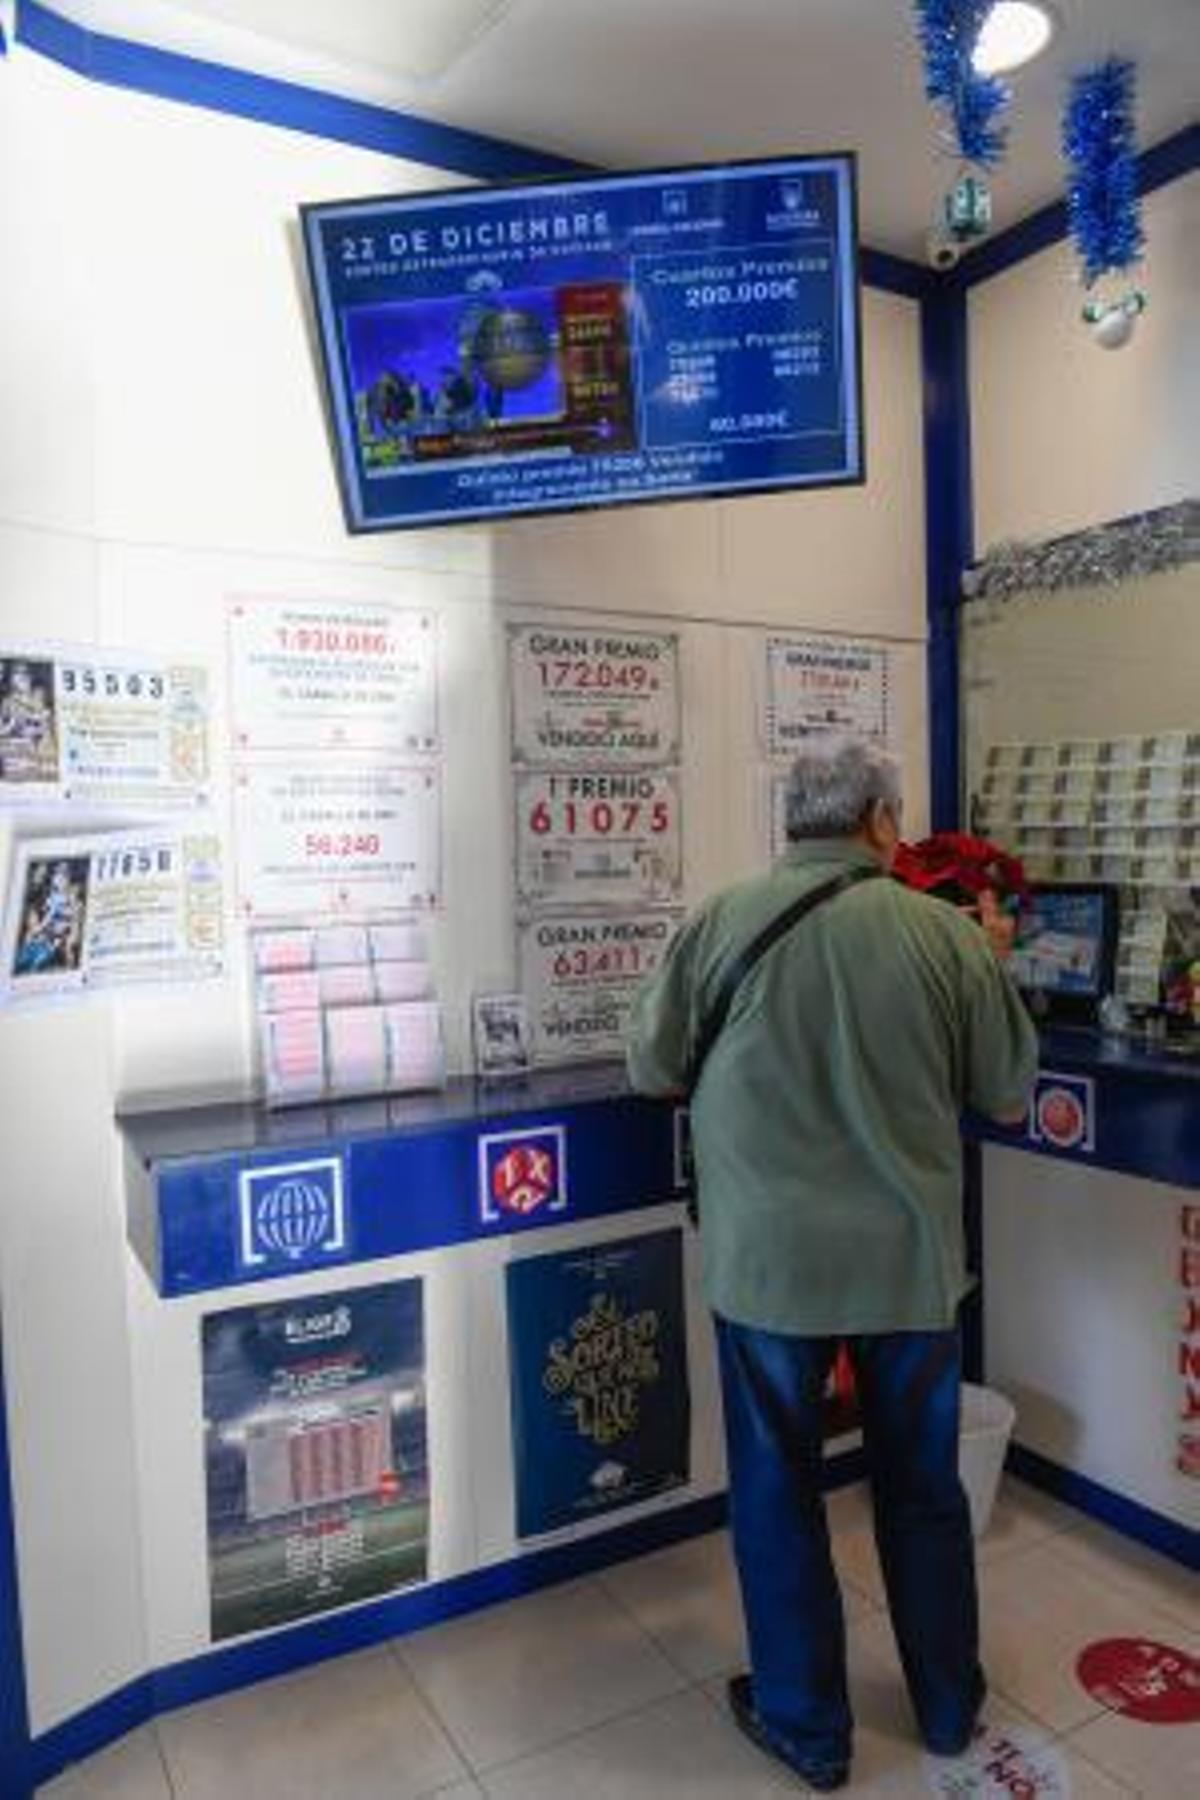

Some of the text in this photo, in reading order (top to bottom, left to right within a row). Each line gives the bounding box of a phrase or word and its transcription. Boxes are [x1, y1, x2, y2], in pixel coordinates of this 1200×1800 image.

[388, 229, 429, 255] DE
[441, 211, 609, 249] DICIEMBRE
[529, 633, 659, 660] GRAN PREMIO
[569, 777, 654, 799] PREMIO
[530, 801, 669, 835] 61075
[537, 921, 667, 947] GRAN PREMIO
